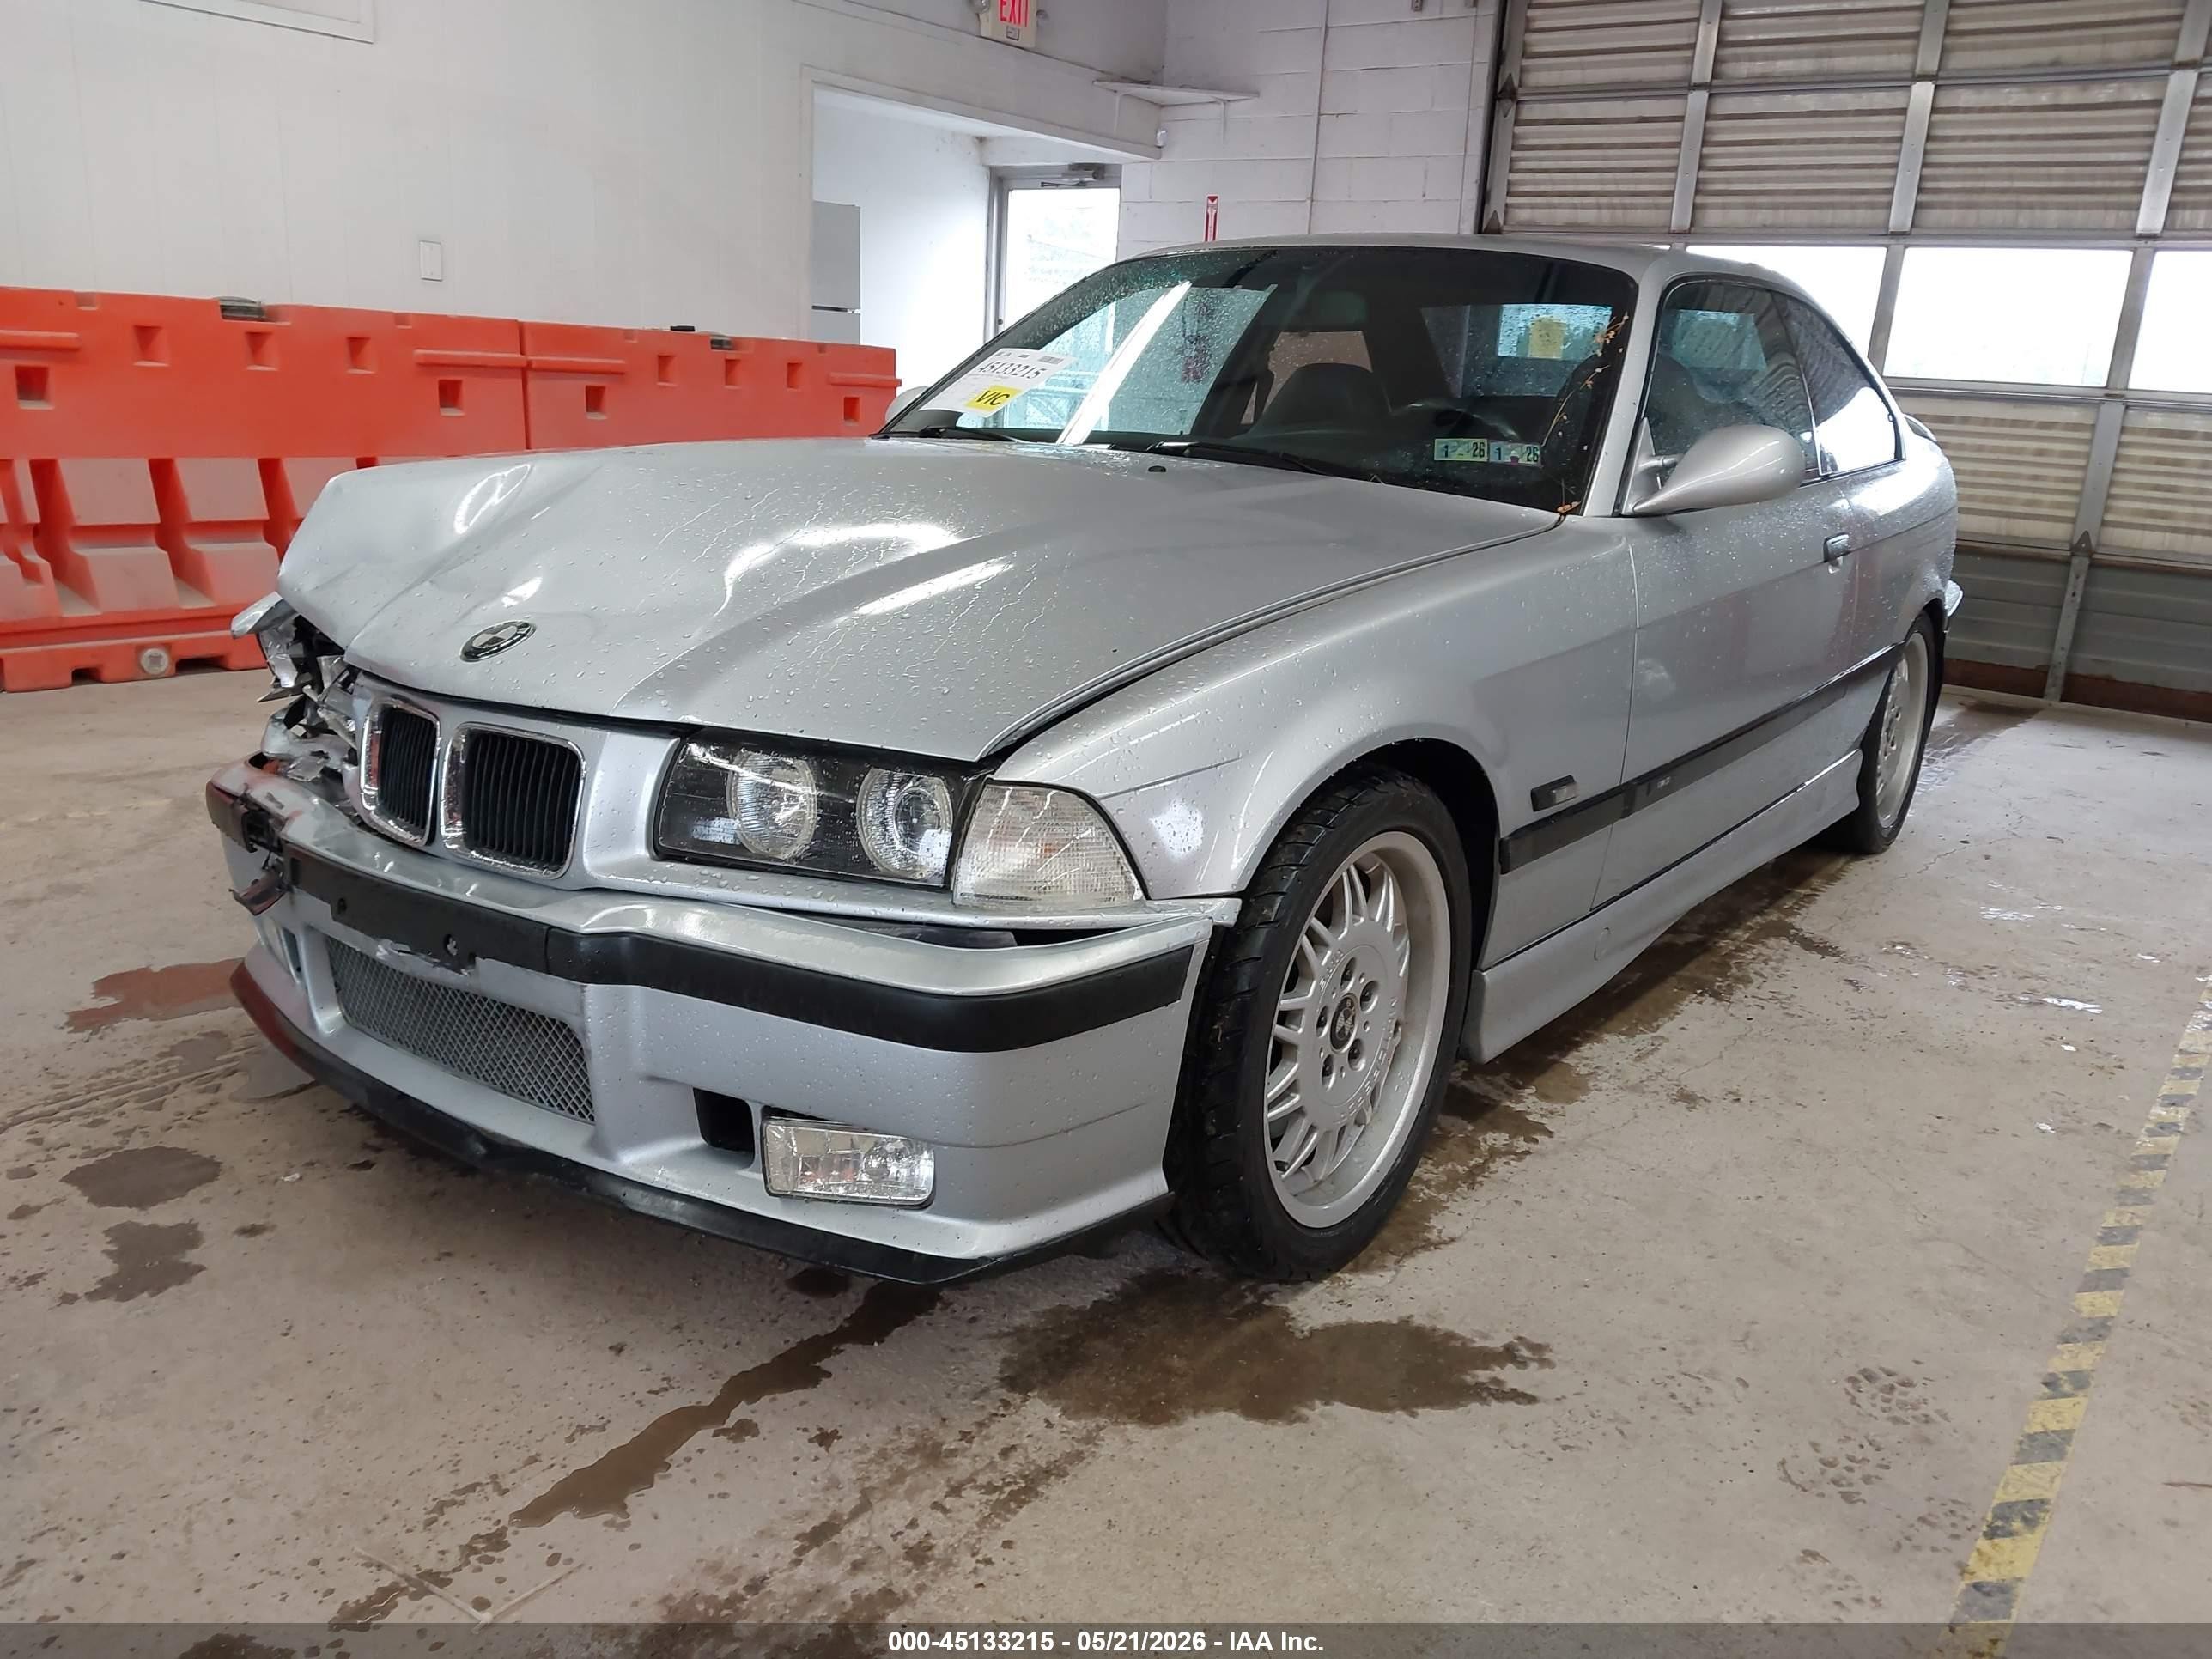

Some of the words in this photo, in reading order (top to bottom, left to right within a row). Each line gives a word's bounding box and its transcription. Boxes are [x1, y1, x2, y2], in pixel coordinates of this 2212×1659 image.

[1000, 0, 1029, 27] EXIT
[979, 361, 1048, 380] 45133215
[976, 390, 1011, 406] VIC
[1443, 444, 1449, 458] 1
[1472, 442, 1486, 458] 26
[1495, 447, 1502, 461] 1
[1526, 446, 1540, 462] 26
